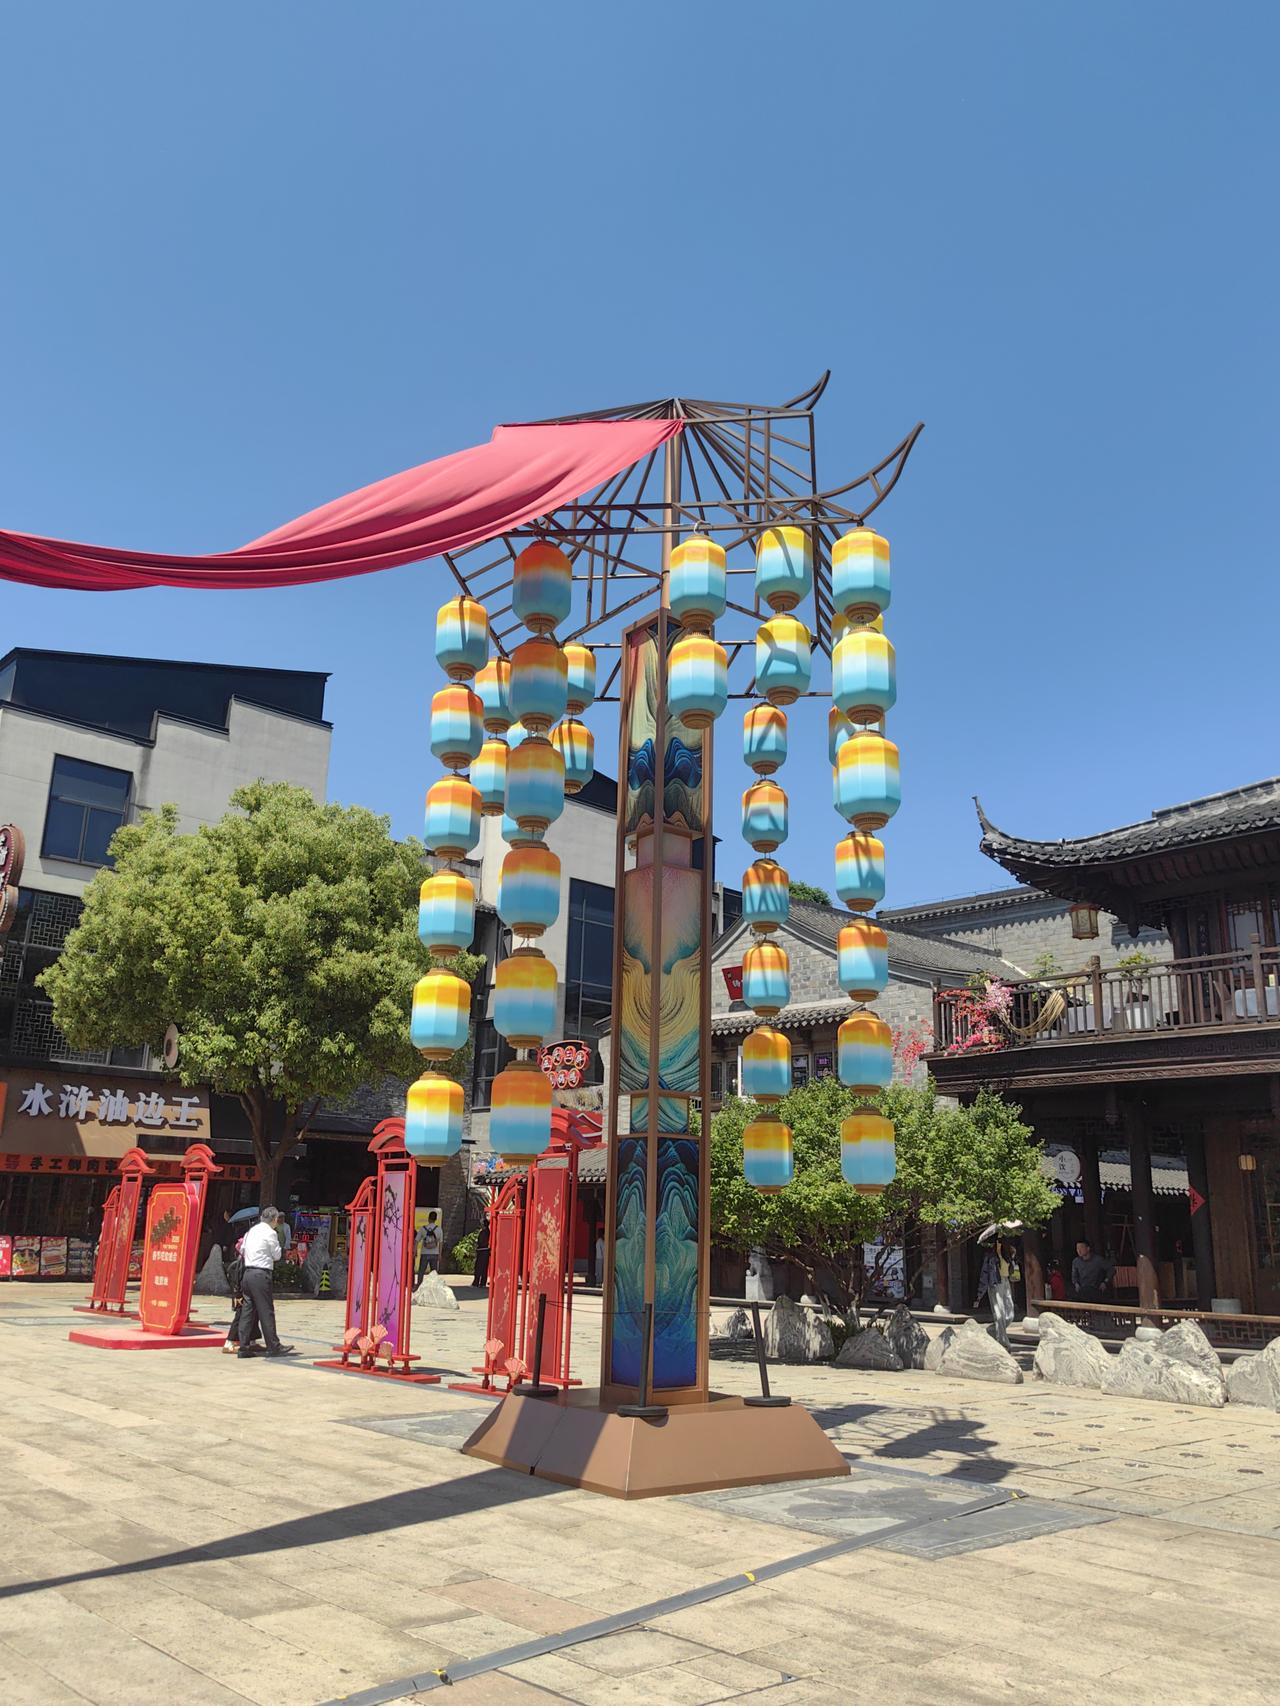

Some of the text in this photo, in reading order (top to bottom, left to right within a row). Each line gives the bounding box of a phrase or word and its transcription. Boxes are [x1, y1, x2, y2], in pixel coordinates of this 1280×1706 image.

[18, 1083, 200, 1127] 水浒油边王
